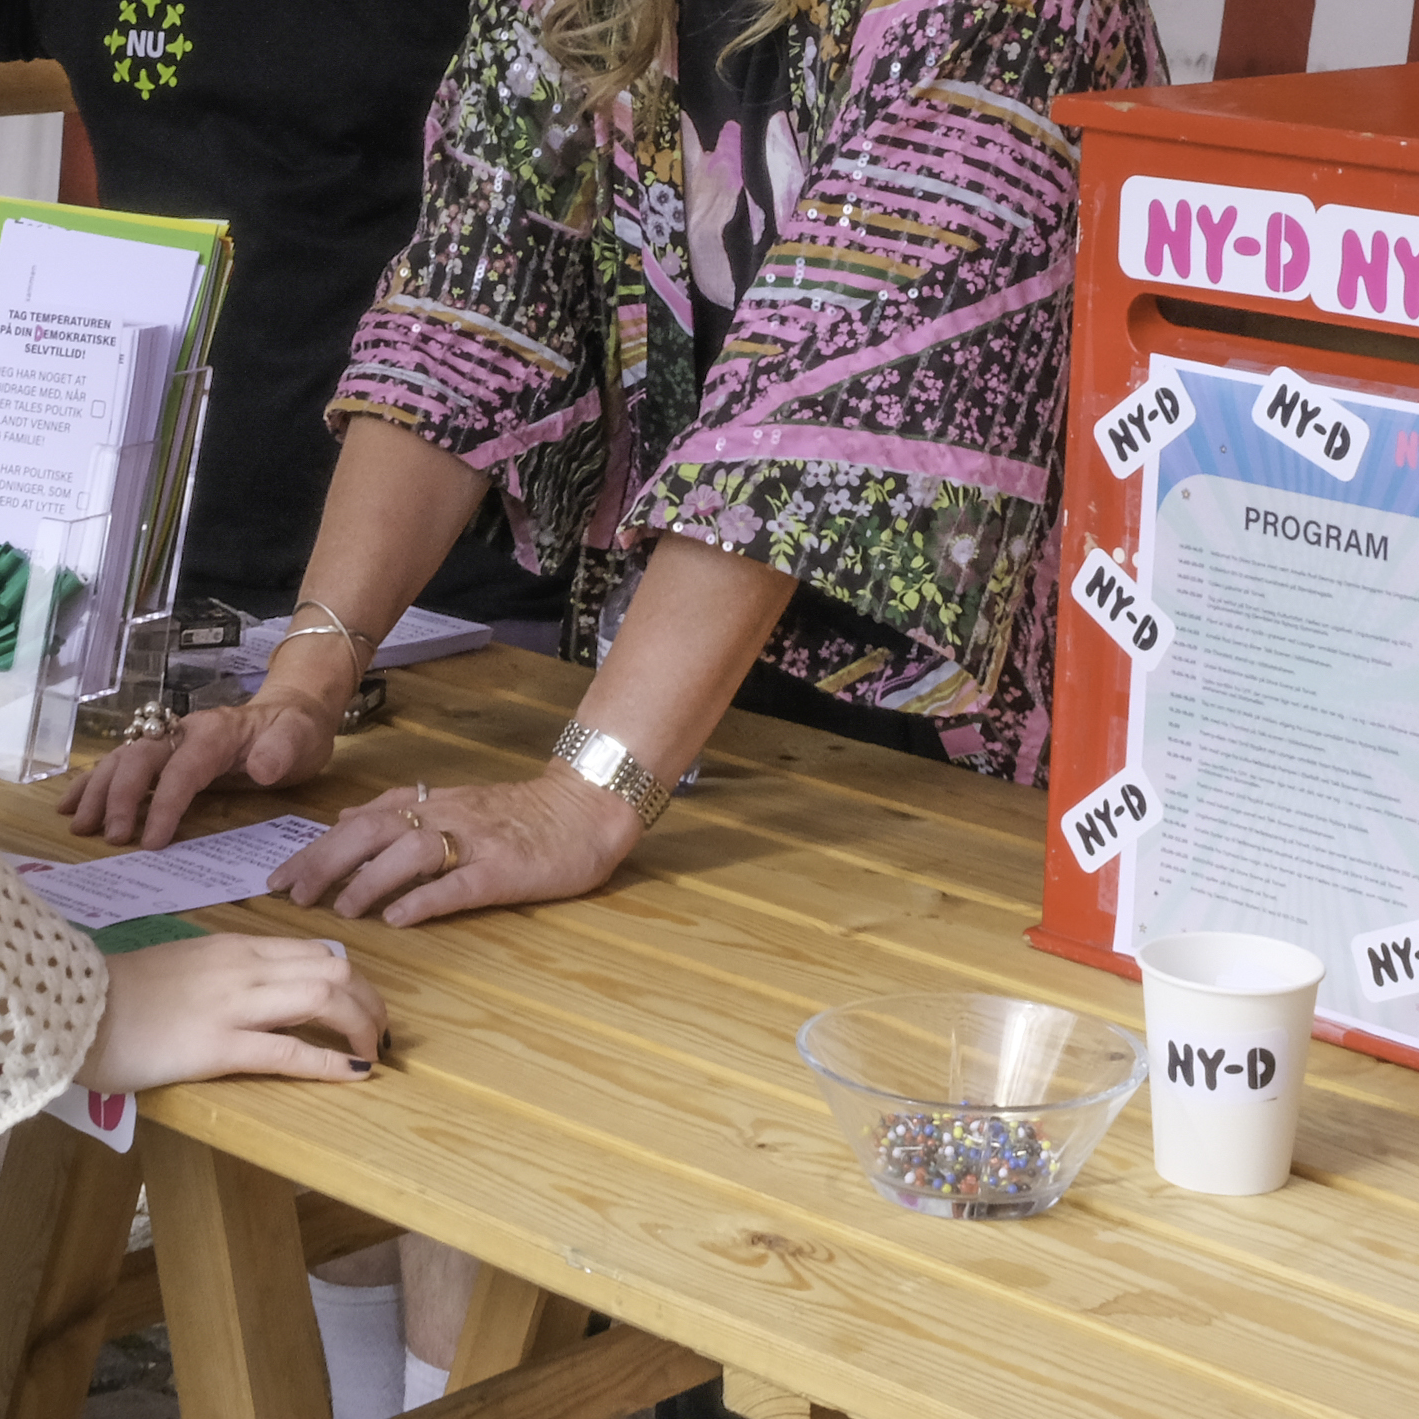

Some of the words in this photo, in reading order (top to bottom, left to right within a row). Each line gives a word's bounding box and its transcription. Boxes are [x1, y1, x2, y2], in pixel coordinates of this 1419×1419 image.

[127, 29, 165, 58] NU
[1145, 198, 1311, 294] NY-D
[9, 309, 27, 322] TAG
[30, 311, 111, 329] TEMPERATUREN
[0, 323, 12, 336] PÅ
[14, 326, 33, 337] DIN
[34, 325, 117, 347] DEMOKRATISKE
[24, 342, 86, 360] SELVTILLID!
[16, 369, 37, 381] HAR
[39, 371, 74, 385] NOGET
[75, 374, 87, 386] AT
[39, 385, 63, 400] MED,
[65, 387, 86, 402] NÅR
[13, 399, 42, 414] TALES
[44, 402, 83, 418] POLITIK
[30, 418, 71, 433] VENNER
[1108, 386, 1180, 462] NY-D
[1266, 383, 1351, 462] NY-D
[3, 430, 45, 446] FAMILIE!
[0, 463, 21, 477] HAR
[24, 466, 74, 483] POLITISKE
[48, 486, 71, 499] SOM
[21, 499, 33, 510] AT
[35, 500, 65, 515] LYTTE
[1244, 506, 1389, 561] PROGRAM
[1085, 565, 1158, 652] NY-D
[1075, 783, 1147, 855] NY-D
[1168, 1039, 1275, 1090] NY-D
